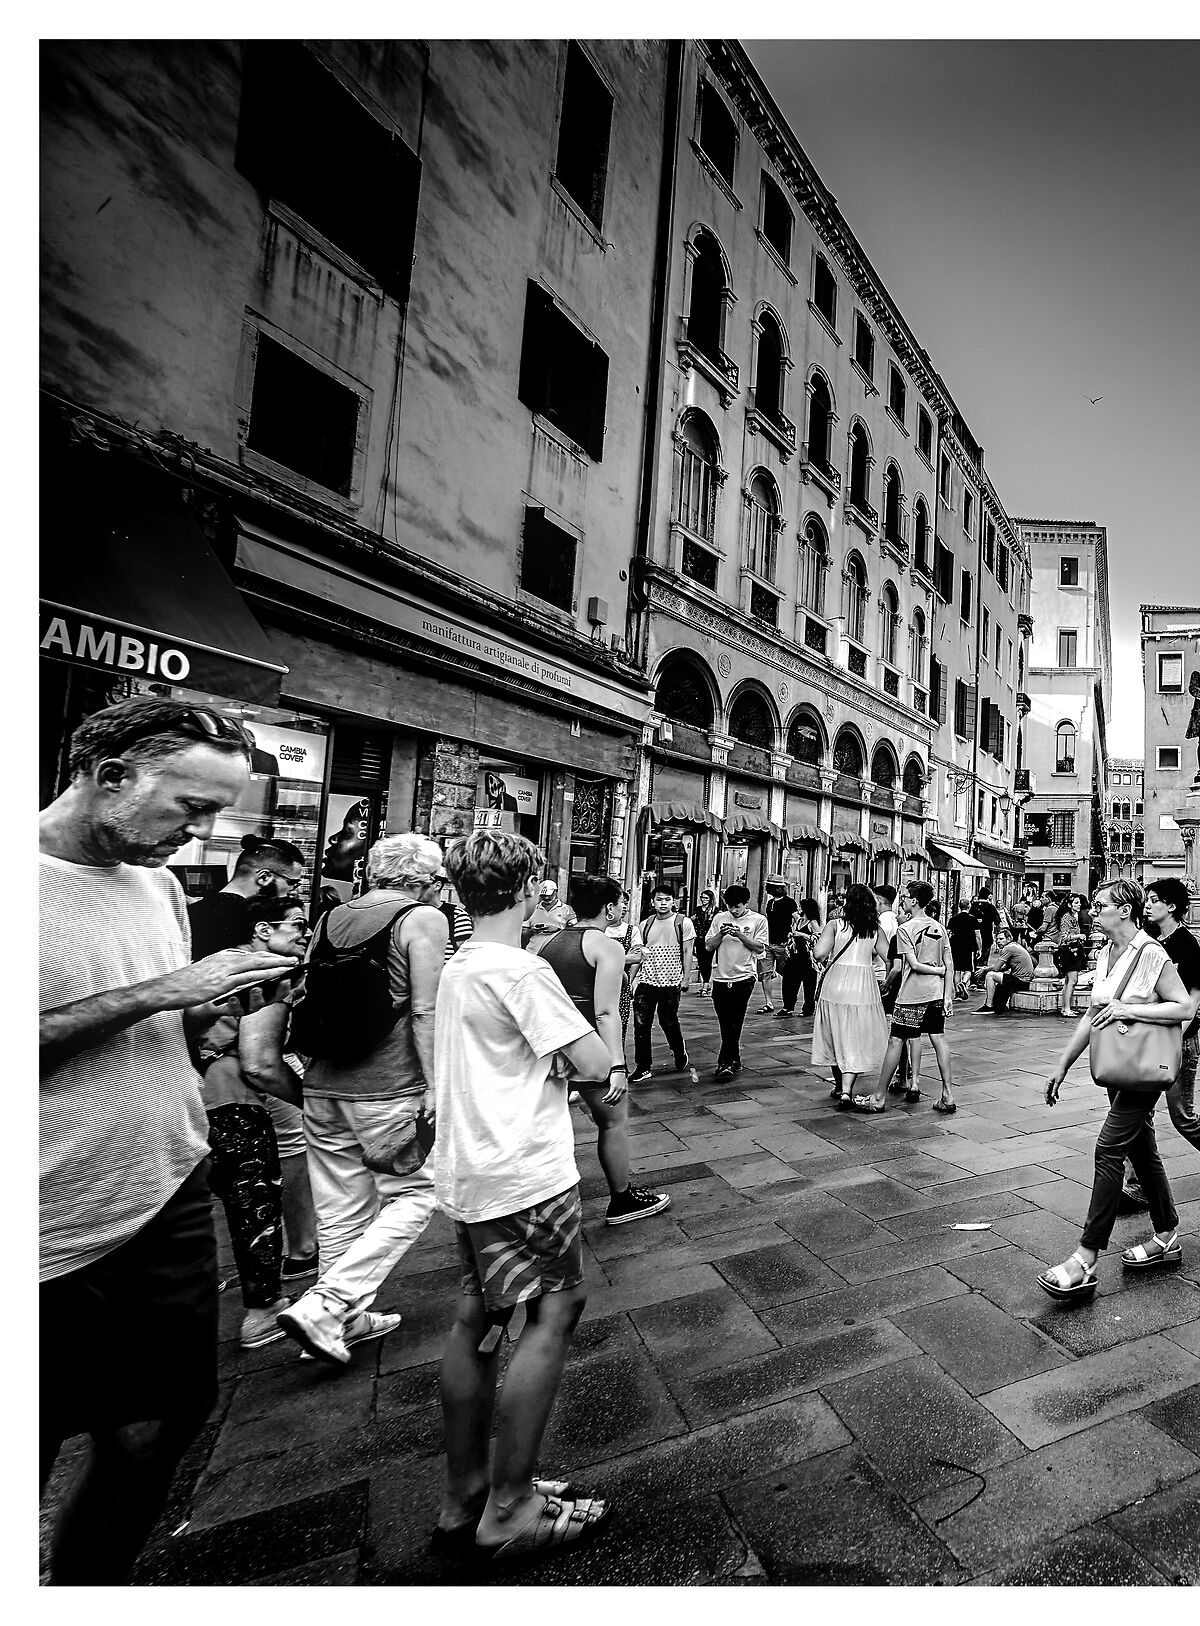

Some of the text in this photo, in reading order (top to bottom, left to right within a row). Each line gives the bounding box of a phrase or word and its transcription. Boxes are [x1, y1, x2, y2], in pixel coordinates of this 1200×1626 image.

[40, 617, 190, 681] AMBIO
[422, 619, 571, 687] manifattura artigianale di profumi
[279, 744, 307, 755] CAMBIA
[279, 752, 304, 763] COVER
